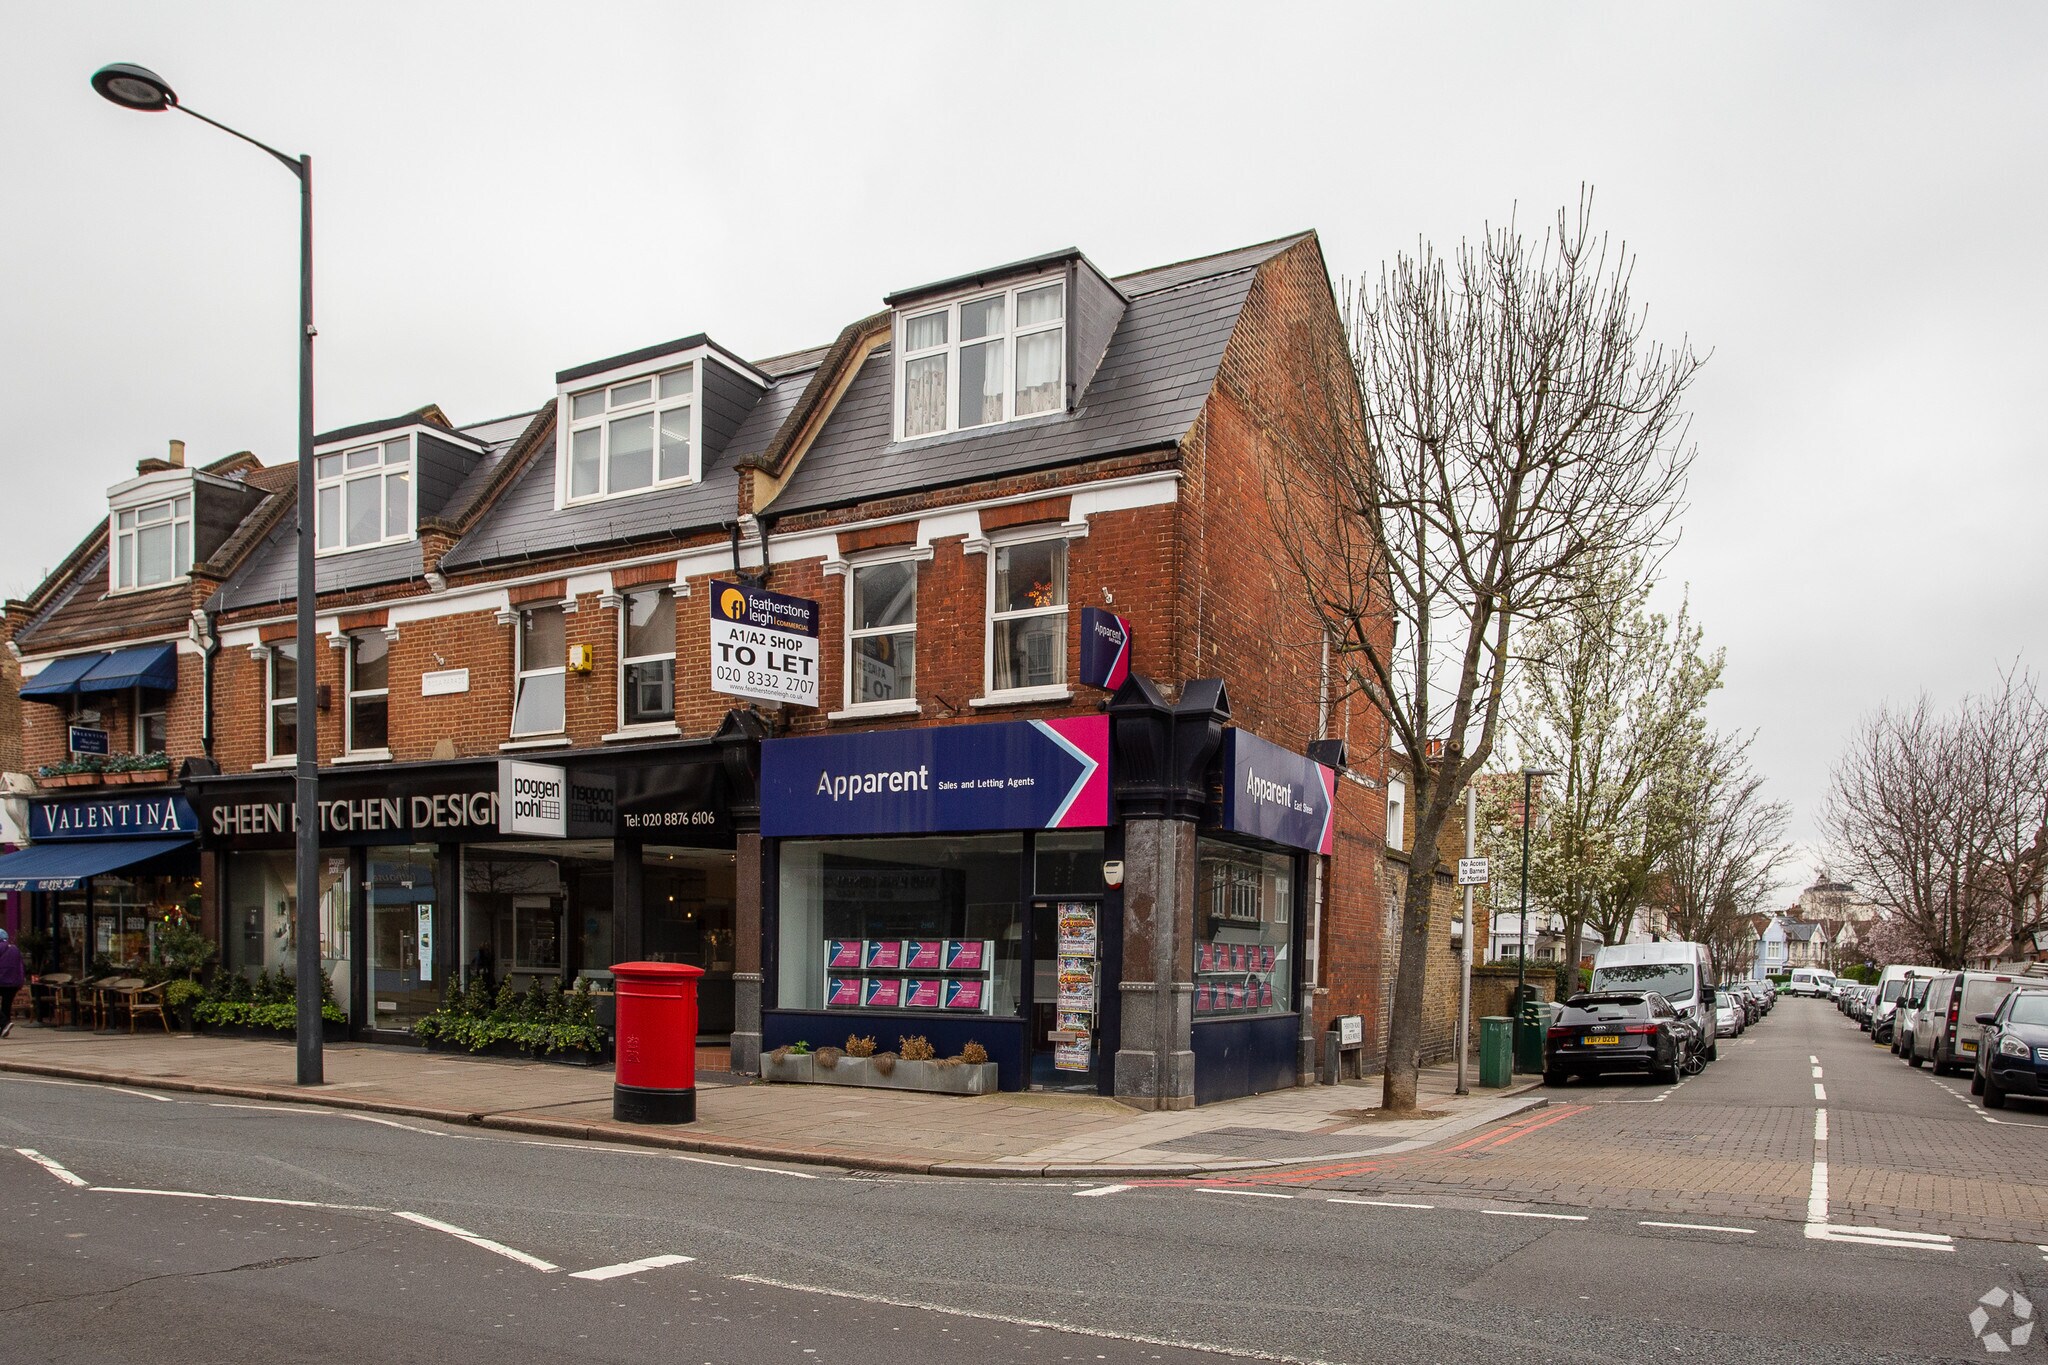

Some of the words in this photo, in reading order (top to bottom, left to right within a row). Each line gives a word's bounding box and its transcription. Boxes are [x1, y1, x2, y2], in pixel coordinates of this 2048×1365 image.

[749, 595, 809, 619] featherstone
[749, 608, 773, 626] leigh
[776, 618, 809, 631] COMMERCIAL
[1095, 621, 1121, 640] Apparent
[729, 628, 766, 645] A1/A2
[770, 635, 802, 651] SHOP
[717, 642, 755, 666] TO
[767, 651, 813, 676] LET
[717, 665, 740, 682] 020
[747, 671, 779, 688] 8332
[786, 677, 814, 694] 2707
[729, 683, 803, 700] www.featherstoneleigh.co.uk
[514, 777, 560, 799] poggen
[816, 765, 929, 801] Apparent
[938, 781, 957, 790] Sales
[961, 780, 974, 789] and
[977, 778, 1004, 789] Letting
[1007, 777, 1035, 788] Agents
[1246, 766, 1291, 808] Apparent
[1293, 800, 1302, 811] East
[1303, 803, 1313, 815] Sheen
[43, 797, 181, 832] VALENTINA
[212, 802, 285, 835] SHEEN
[292, 797, 402, 832] TCHEN
[514, 800, 541, 819] pohl
[623, 814, 641, 828] Tel:
[642, 813, 661, 826] 020
[664, 812, 689, 826] 8876
[692, 811, 715, 825] 6106
